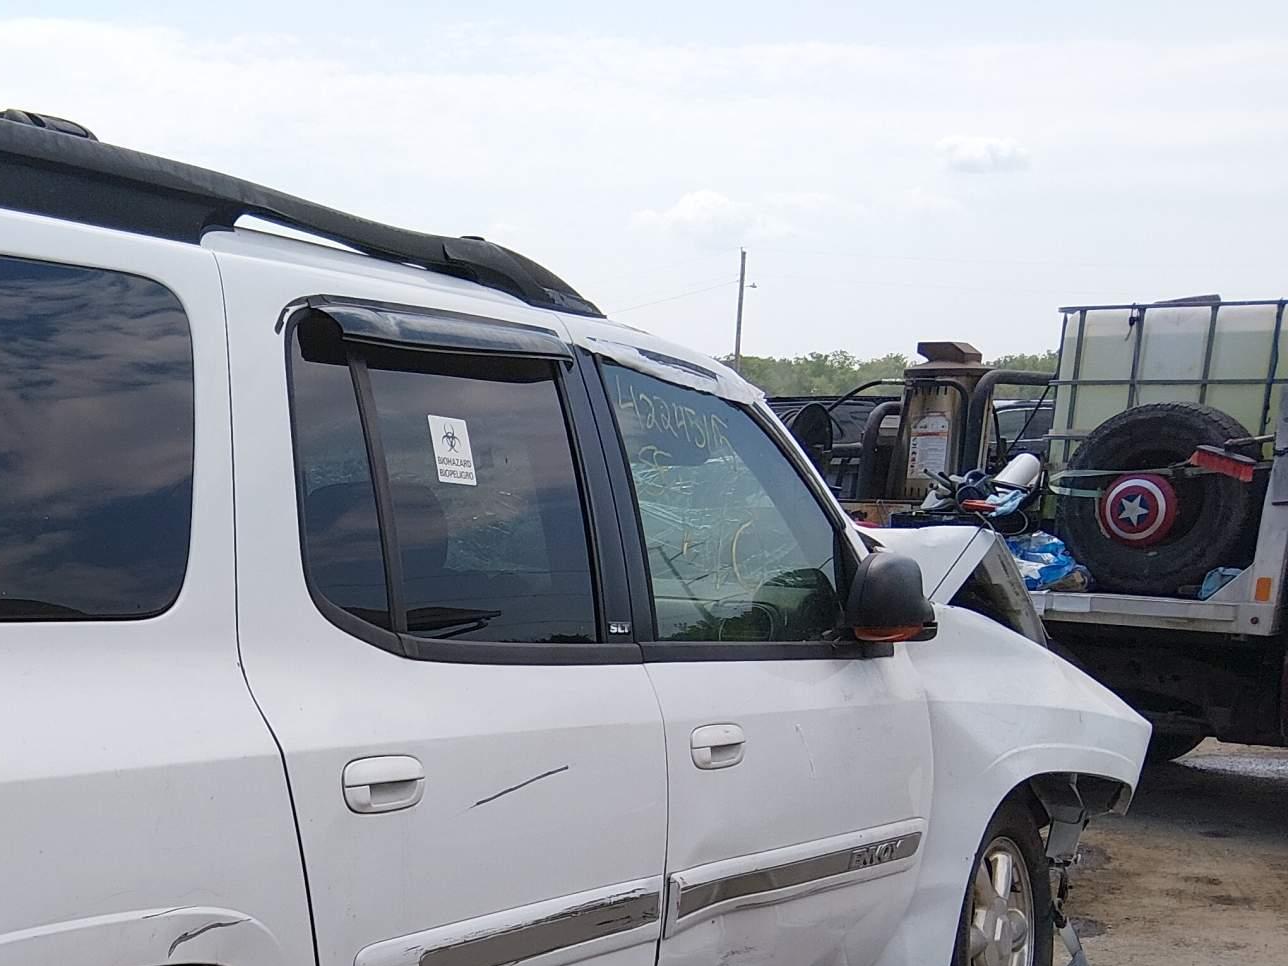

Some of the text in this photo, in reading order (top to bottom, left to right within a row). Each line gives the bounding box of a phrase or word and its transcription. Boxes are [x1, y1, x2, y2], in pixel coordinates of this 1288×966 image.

[437, 456, 472, 468] BIOHAZARD
[439, 468, 475, 480] BIOPELIGRO
[609, 623, 631, 634] SLT
[848, 840, 903, 869] ENVOY
